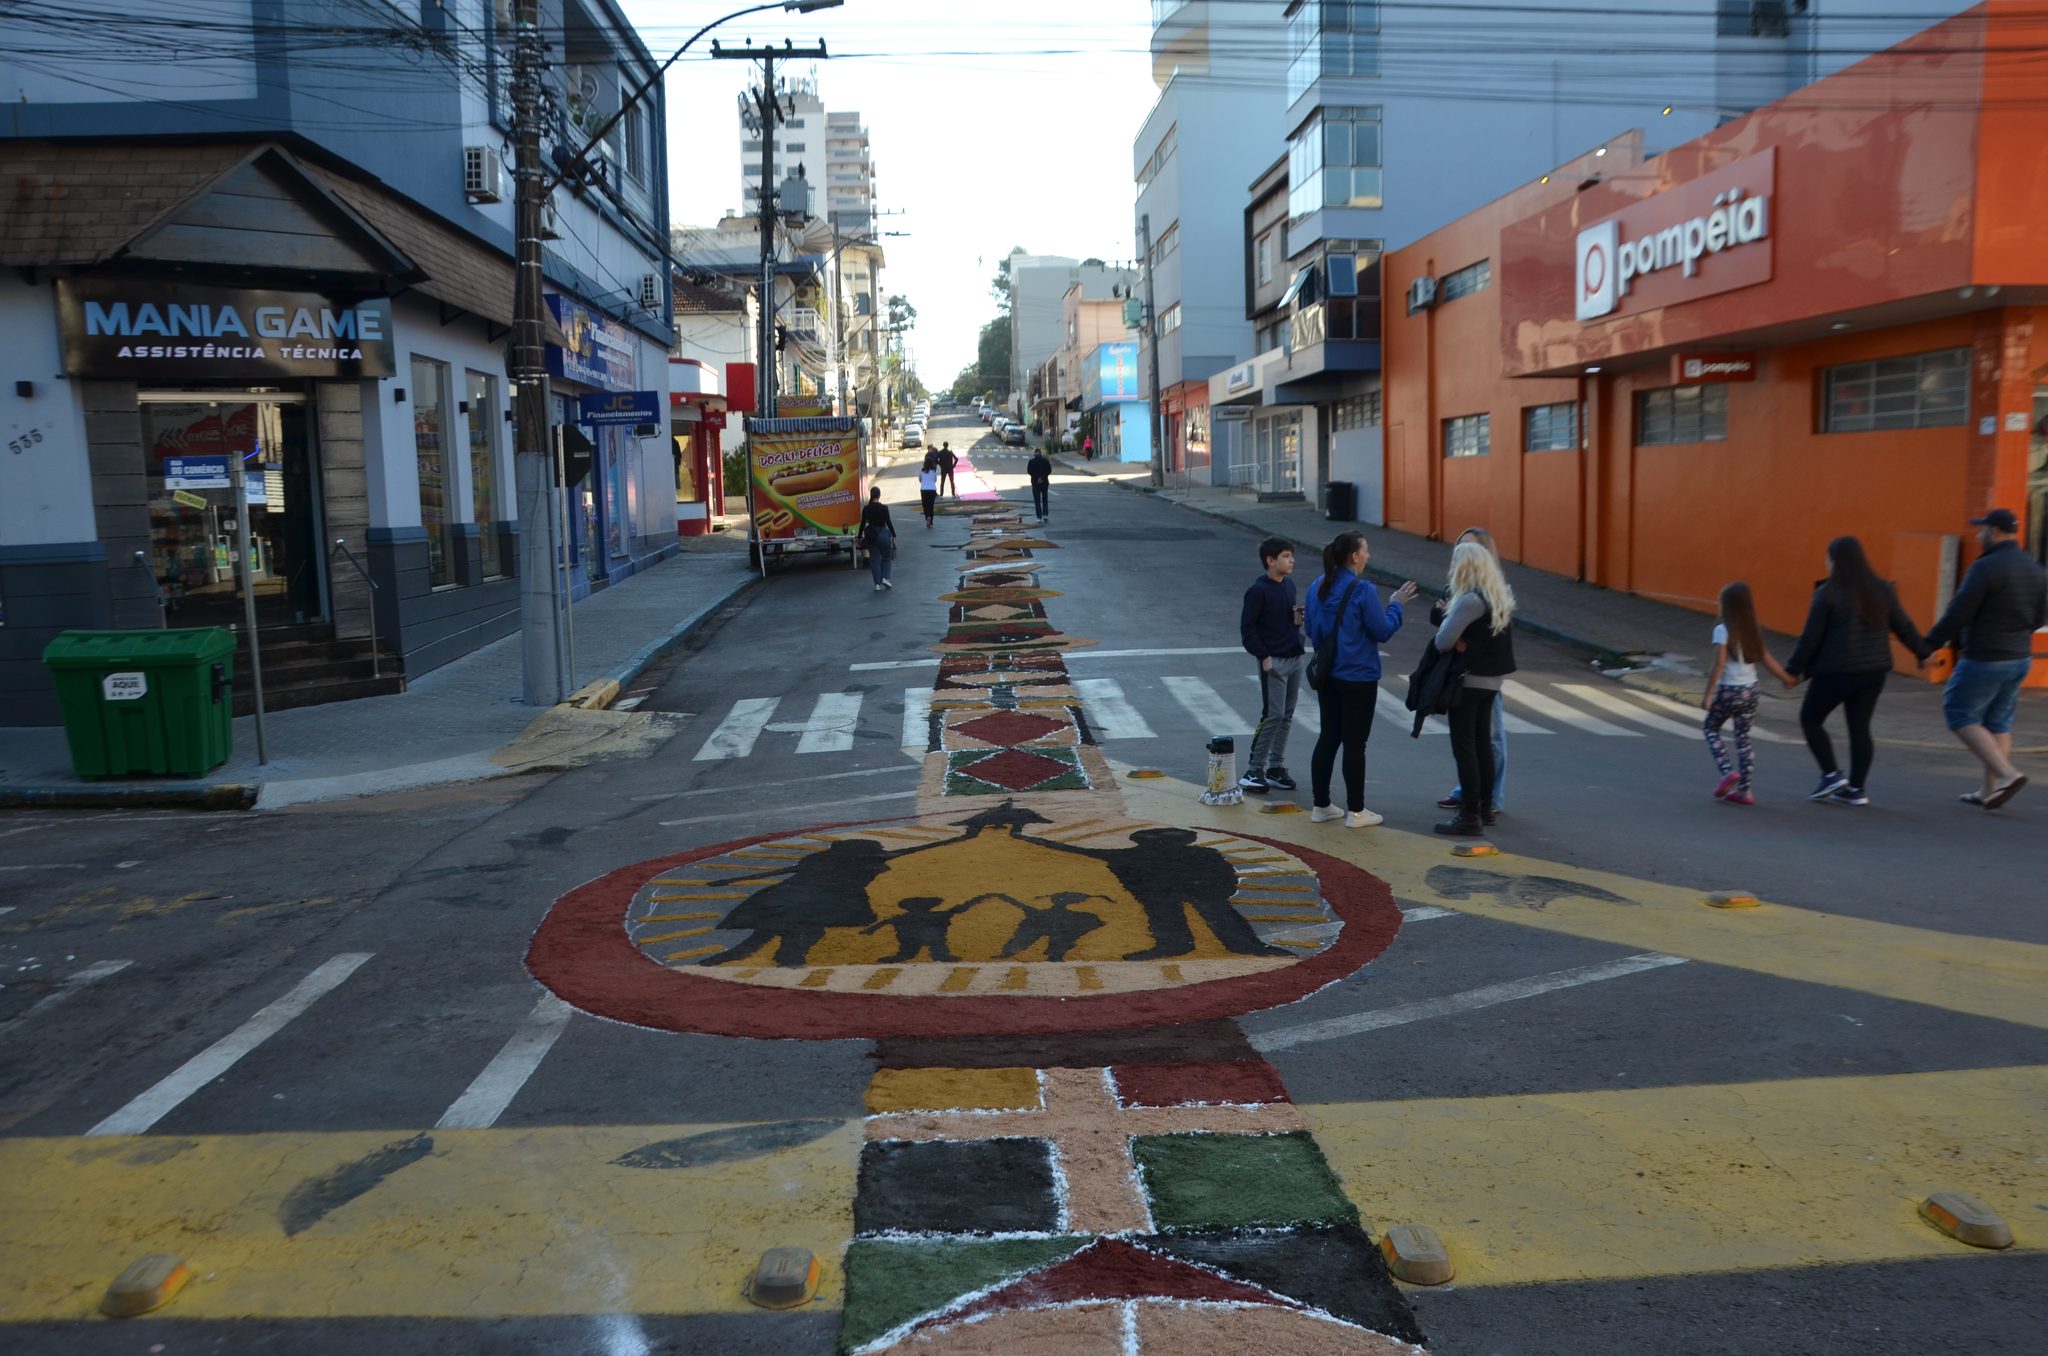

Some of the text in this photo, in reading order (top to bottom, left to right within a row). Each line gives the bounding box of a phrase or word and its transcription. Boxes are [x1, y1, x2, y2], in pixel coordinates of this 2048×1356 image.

[1619, 186, 1769, 299] pompéia
[84, 301, 384, 340] MANIA GAME
[117, 343, 364, 360] ASSISTÊNCIA TÉCNICA
[604, 395, 635, 410] JC
[586, 410, 653, 419] Financiamentos
[760, 454, 784, 468] DOG
[798, 441, 842, 460] DELÍCIA
[171, 463, 225, 475] DO COMÉRCIO
